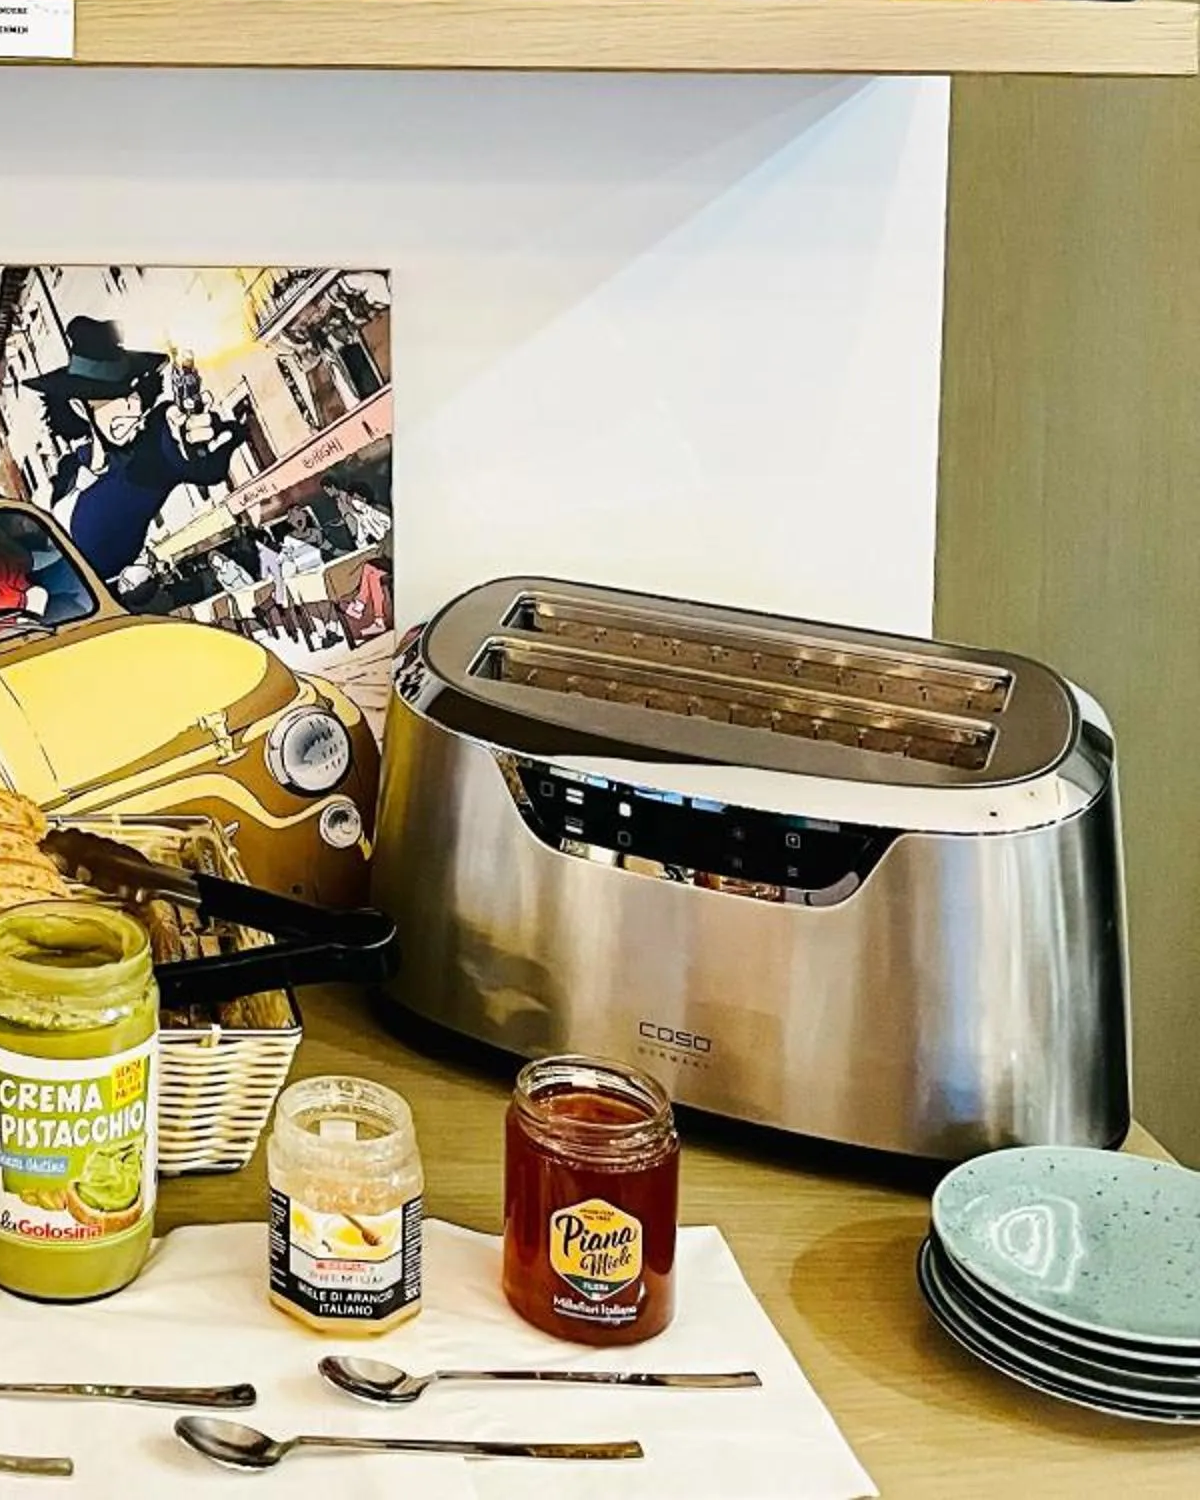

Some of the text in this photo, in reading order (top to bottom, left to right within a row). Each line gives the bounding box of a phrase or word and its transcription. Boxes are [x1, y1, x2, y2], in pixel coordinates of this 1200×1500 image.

[0, 1099, 145, 1149] PISTACCHIO
[297, 1280, 327, 1302] MIELE
[329, 1291, 343, 1302] DI
[319, 1303, 374, 1316] ITALIANO
